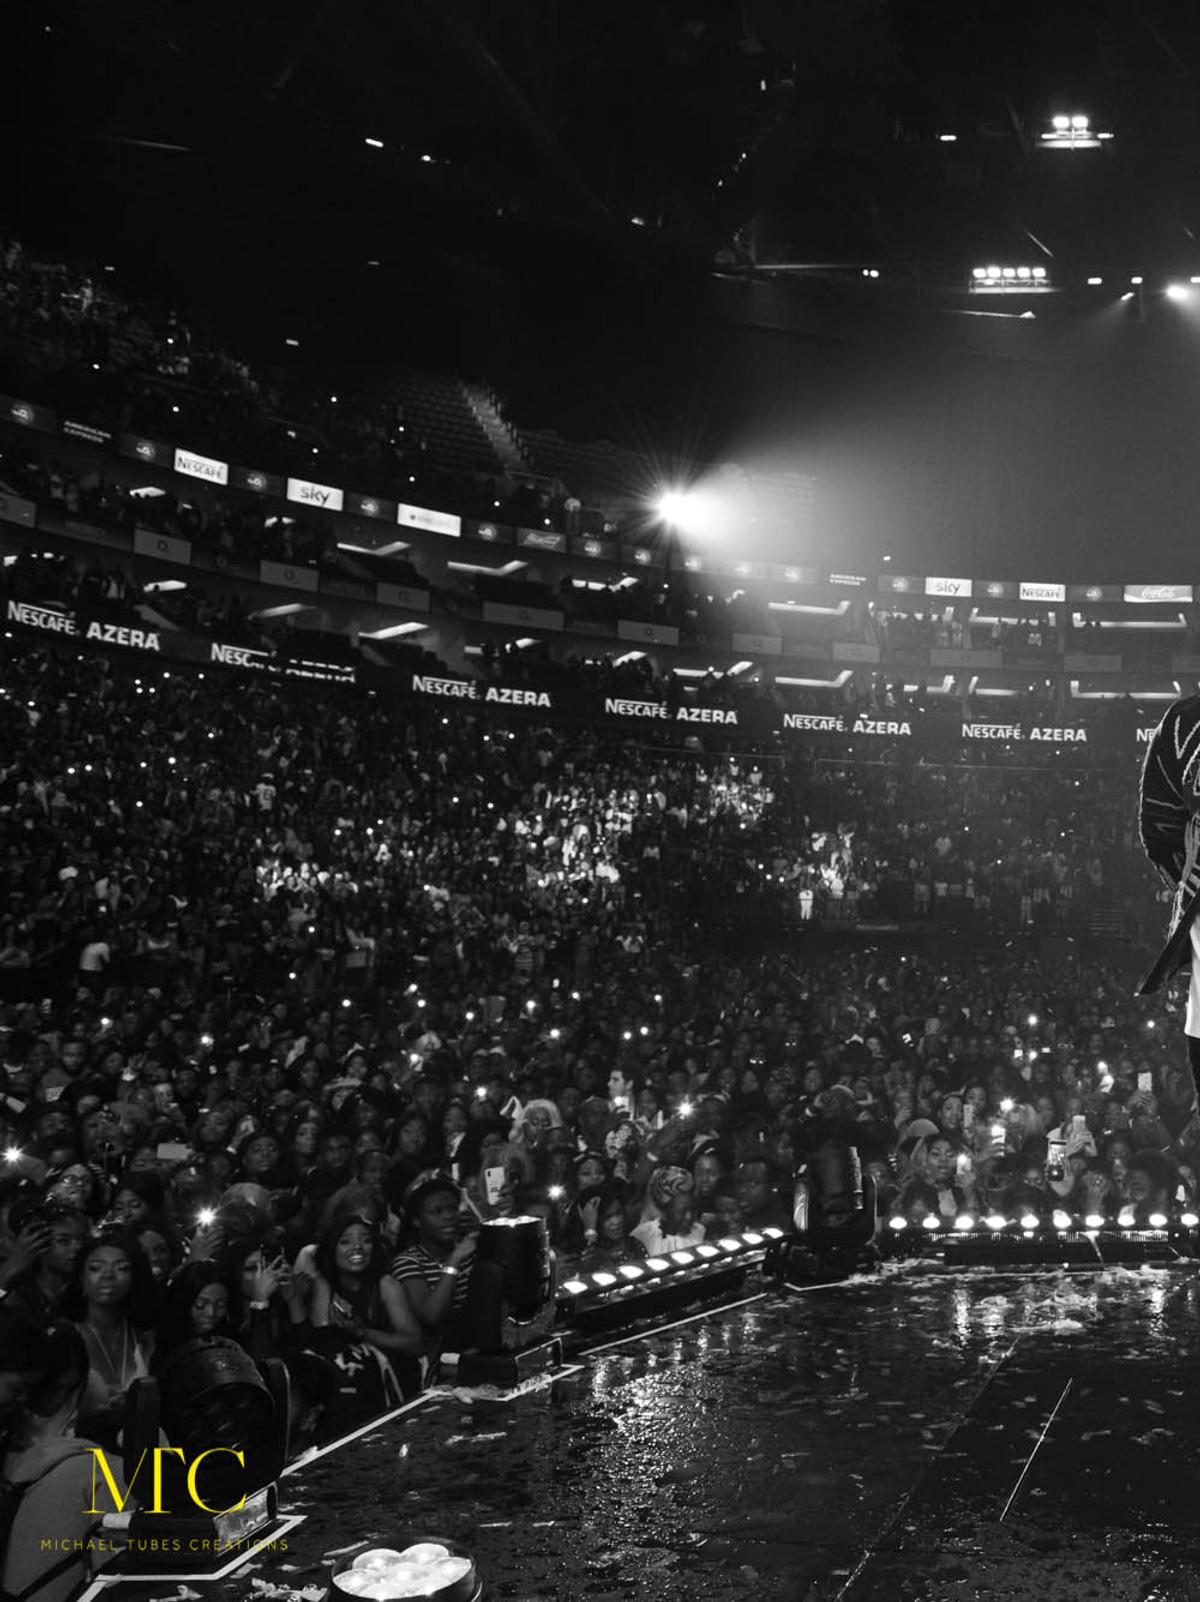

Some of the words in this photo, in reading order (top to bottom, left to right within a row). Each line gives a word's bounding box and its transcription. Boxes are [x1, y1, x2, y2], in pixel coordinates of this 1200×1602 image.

[177, 457, 223, 480] NESCAFÉ
[300, 484, 331, 508] sky
[936, 580, 962, 594] sky
[87, 622, 160, 651] AZERA
[485, 687, 551, 708] AZERA
[676, 706, 738, 725] AZERA
[852, 719, 912, 736] AZERA
[1029, 727, 1087, 742] AZERA
